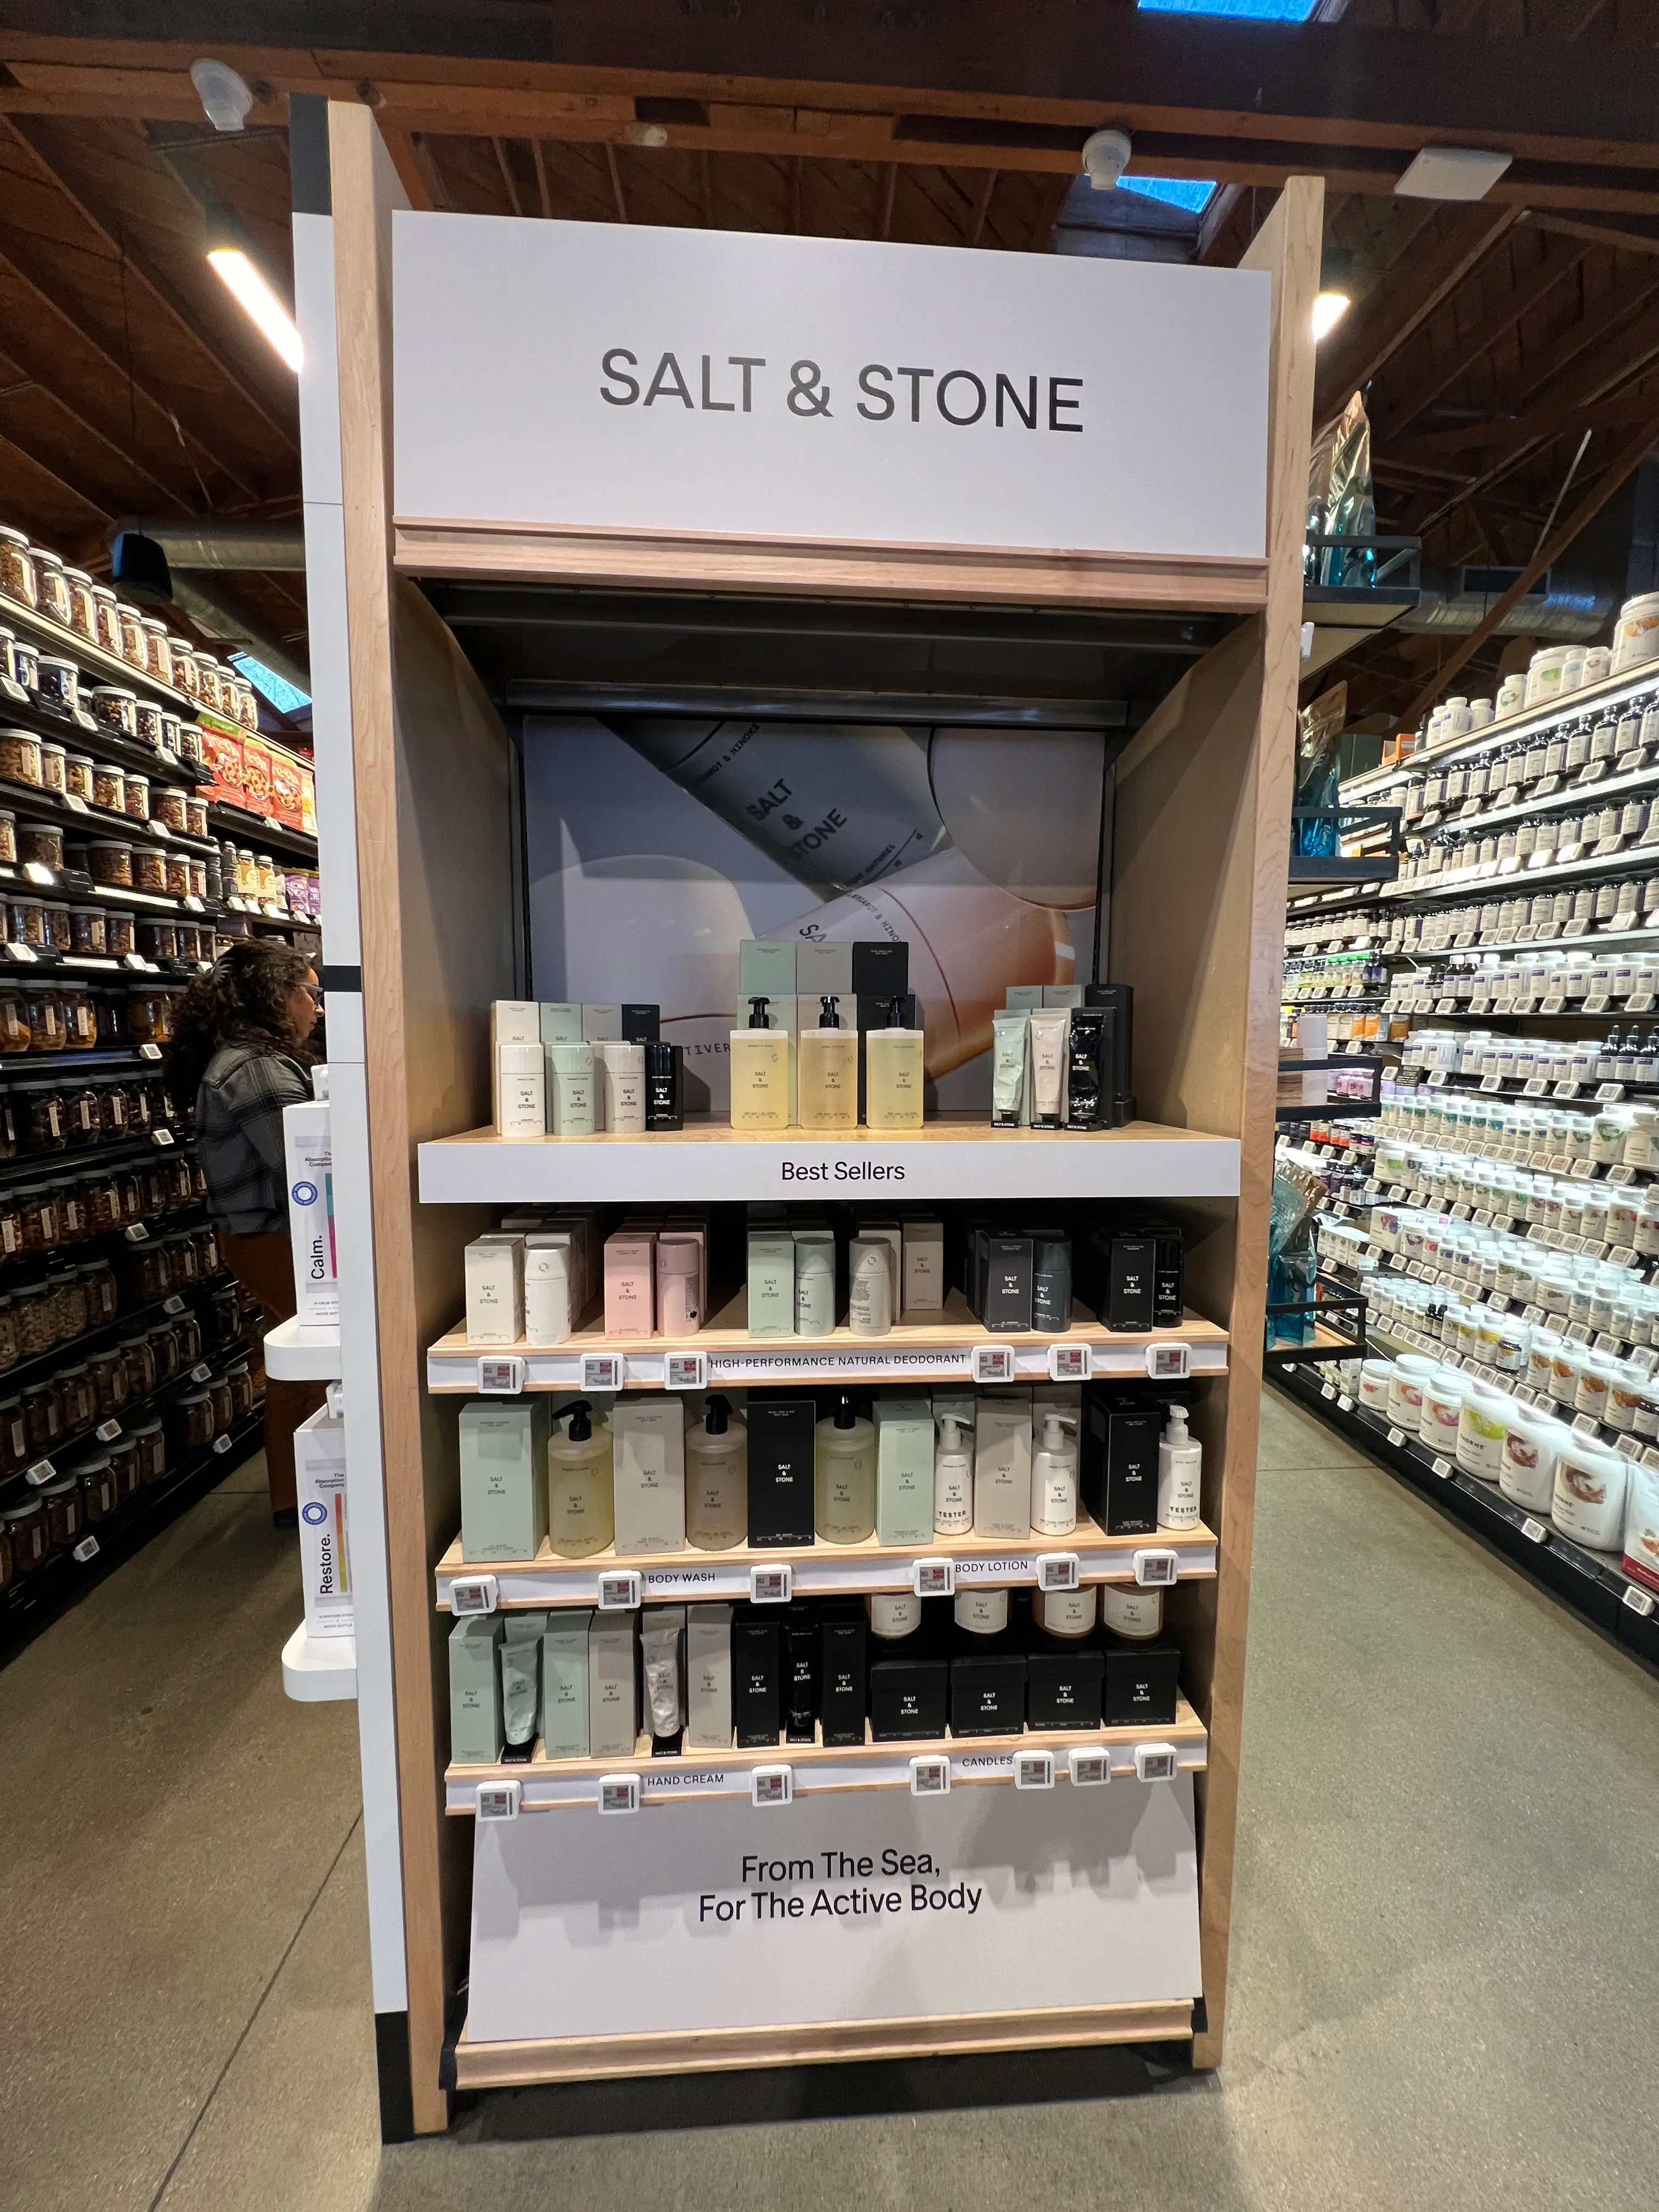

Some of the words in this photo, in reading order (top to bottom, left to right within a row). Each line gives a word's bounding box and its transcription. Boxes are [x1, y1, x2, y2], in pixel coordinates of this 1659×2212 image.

[599, 347, 766, 414] SALT
[786, 359, 833, 419] &
[857, 364, 1084, 433] STONE
[730, 723, 760, 755] HINOKI
[747, 778, 792, 821] SALT
[782, 814, 804, 830] &
[782, 1162, 829, 1181] Best
[834, 1161, 905, 1180] Sellers
[311, 1235, 324, 1280] Calm.
[710, 1357, 834, 1368] HIGH-PERFORMANCE
[838, 1355, 891, 1366] NATURAL
[893, 1354, 966, 1364] DEODORANT
[320, 1534, 333, 1594] Restore.
[955, 1562, 985, 1573] BODY
[988, 1560, 1028, 1572] LOTION
[648, 1574, 681, 1584] BODY
[682, 1573, 715, 1583] WASH
[962, 1756, 1013, 1767] CANDLES
[647, 1776, 680, 1787] HAND
[683, 1774, 725, 1784] CREAM
[742, 1853, 814, 1882] From
[820, 1851, 875, 1877] The
[882, 1849, 941, 1877] Sea,
[699, 1894, 746, 1922] For
[750, 1890, 805, 1918] The
[811, 1886, 901, 1915] Active
[911, 1882, 983, 1915] Body
